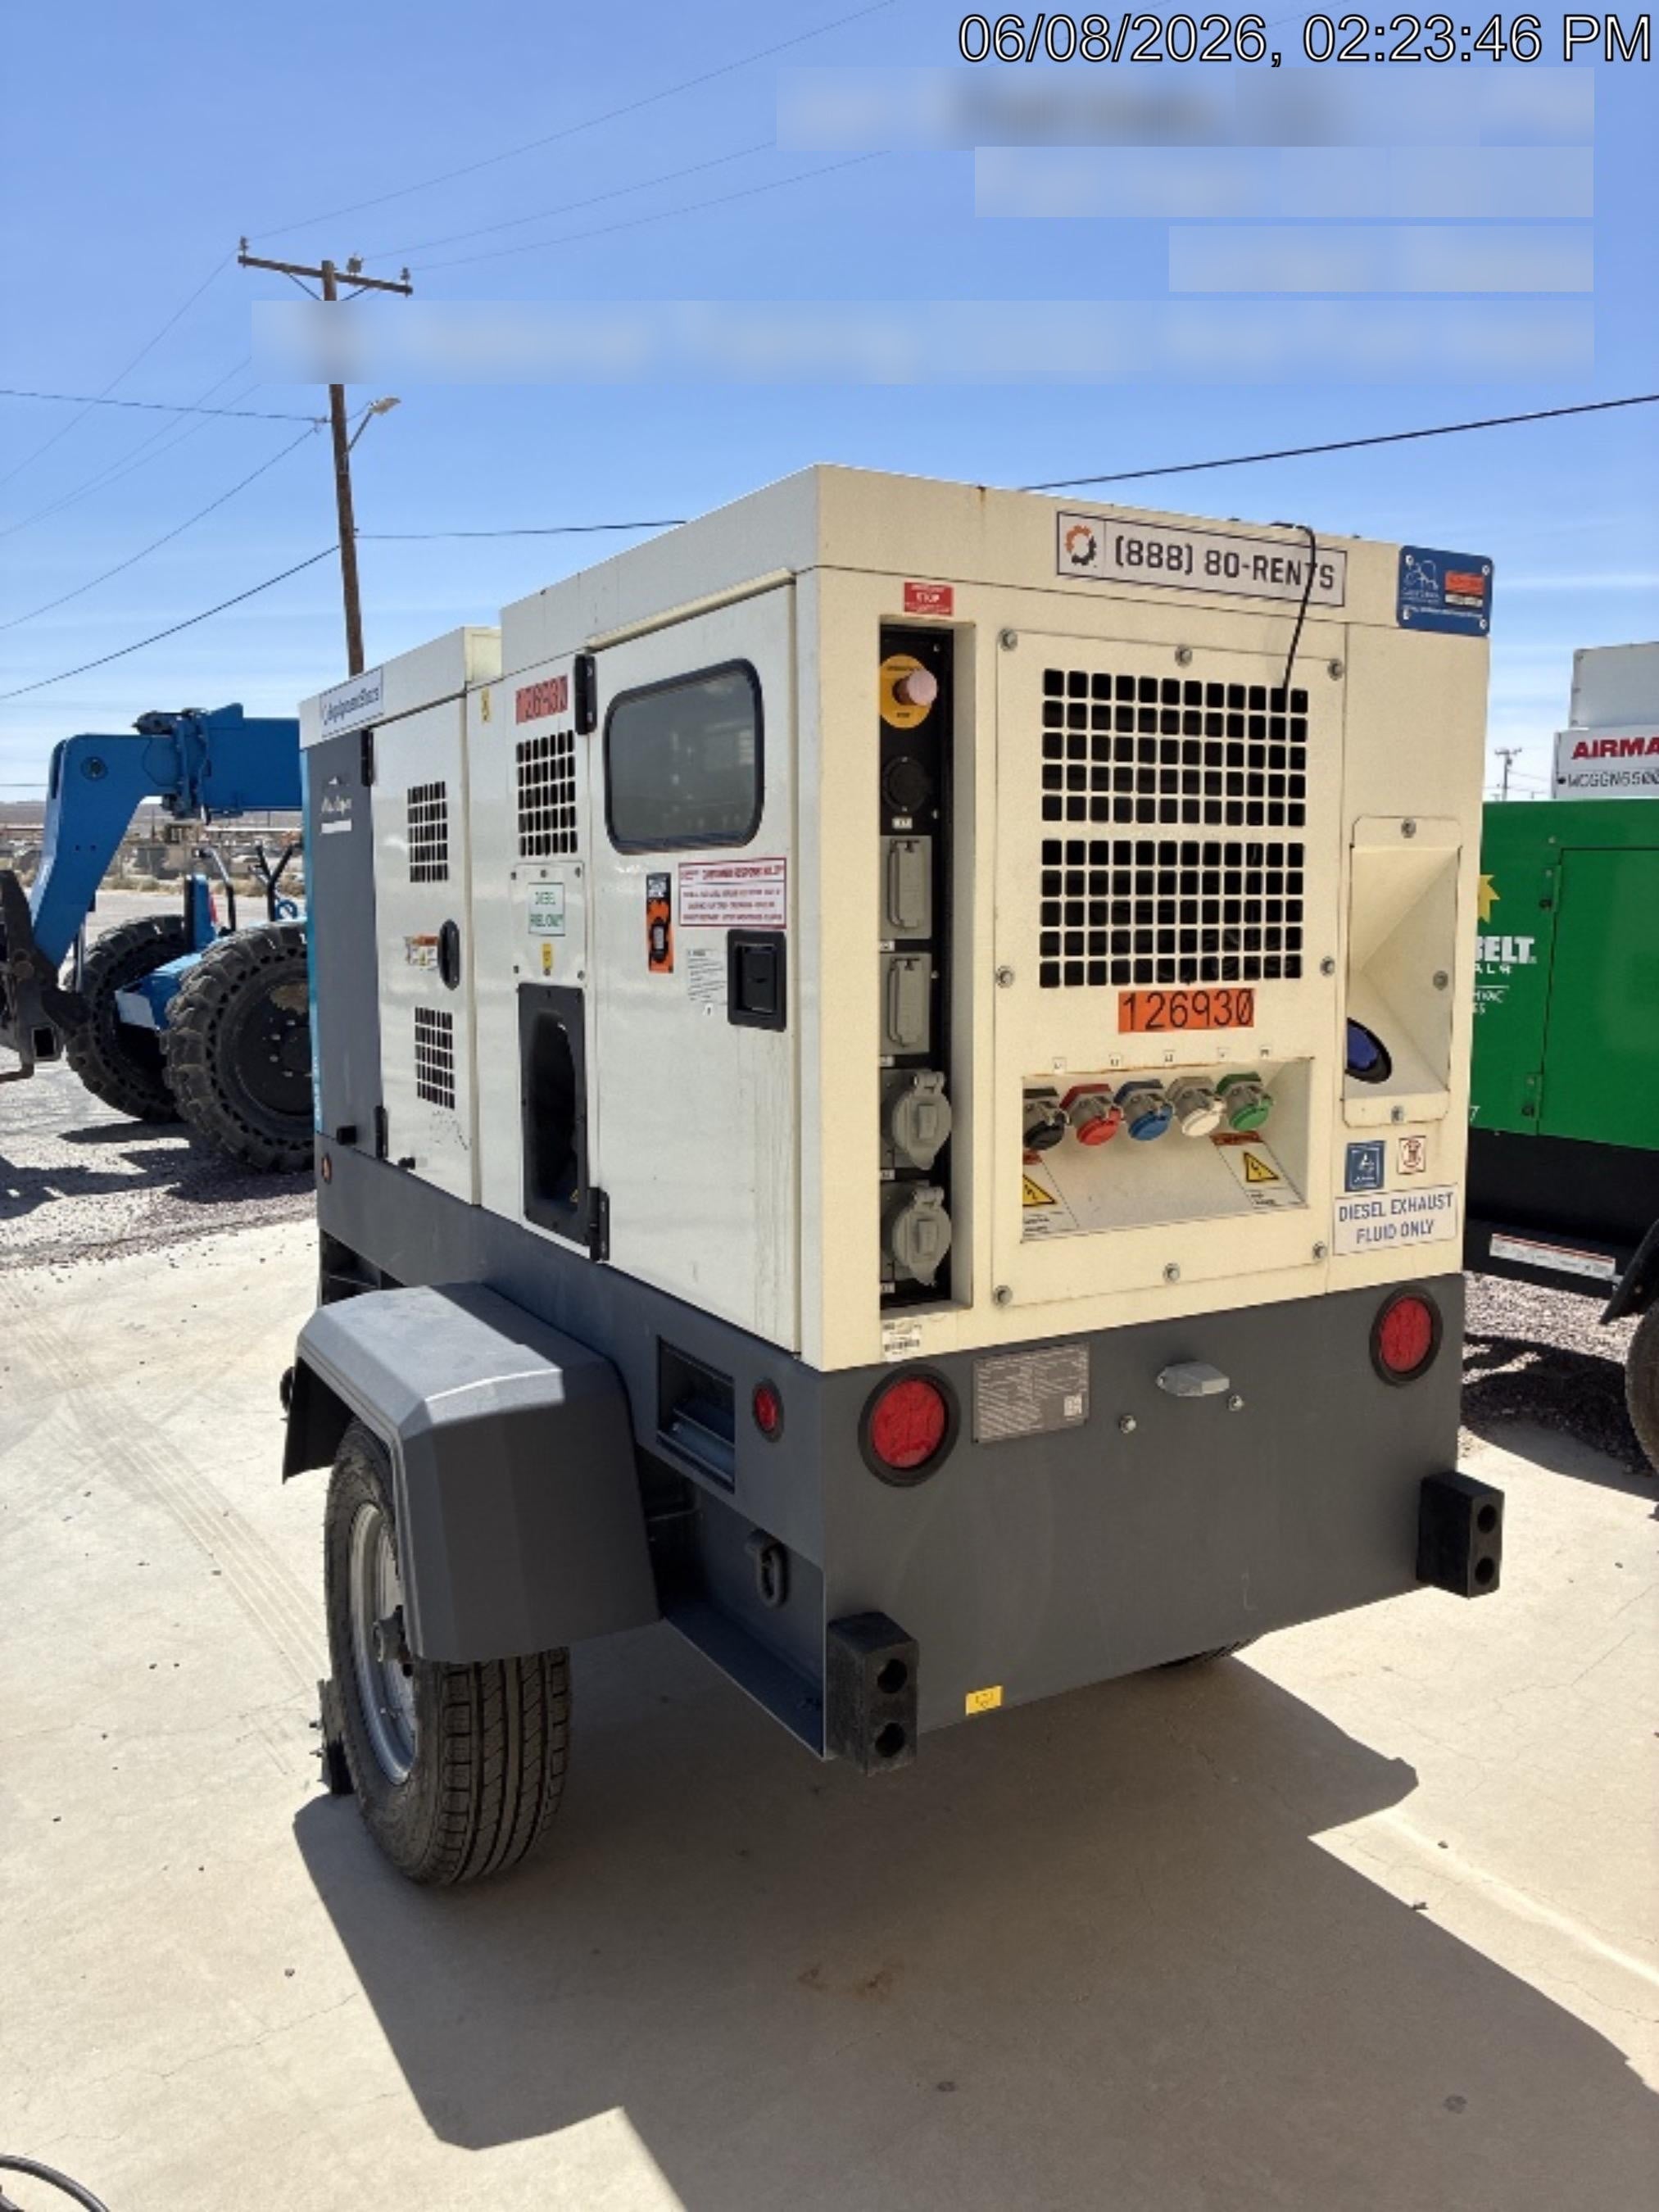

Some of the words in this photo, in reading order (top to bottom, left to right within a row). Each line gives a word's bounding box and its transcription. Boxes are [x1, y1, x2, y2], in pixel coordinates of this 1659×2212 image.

[1116, 535, 1193, 575] (888)
[1123, 988, 1254, 1031] 126930
[1339, 1201, 1386, 1222] DIESEL
[1390, 1192, 1454, 1216] EXHAUST
[1356, 1222, 1397, 1244] FLUID
[1400, 1218, 1435, 1238] ONLY
